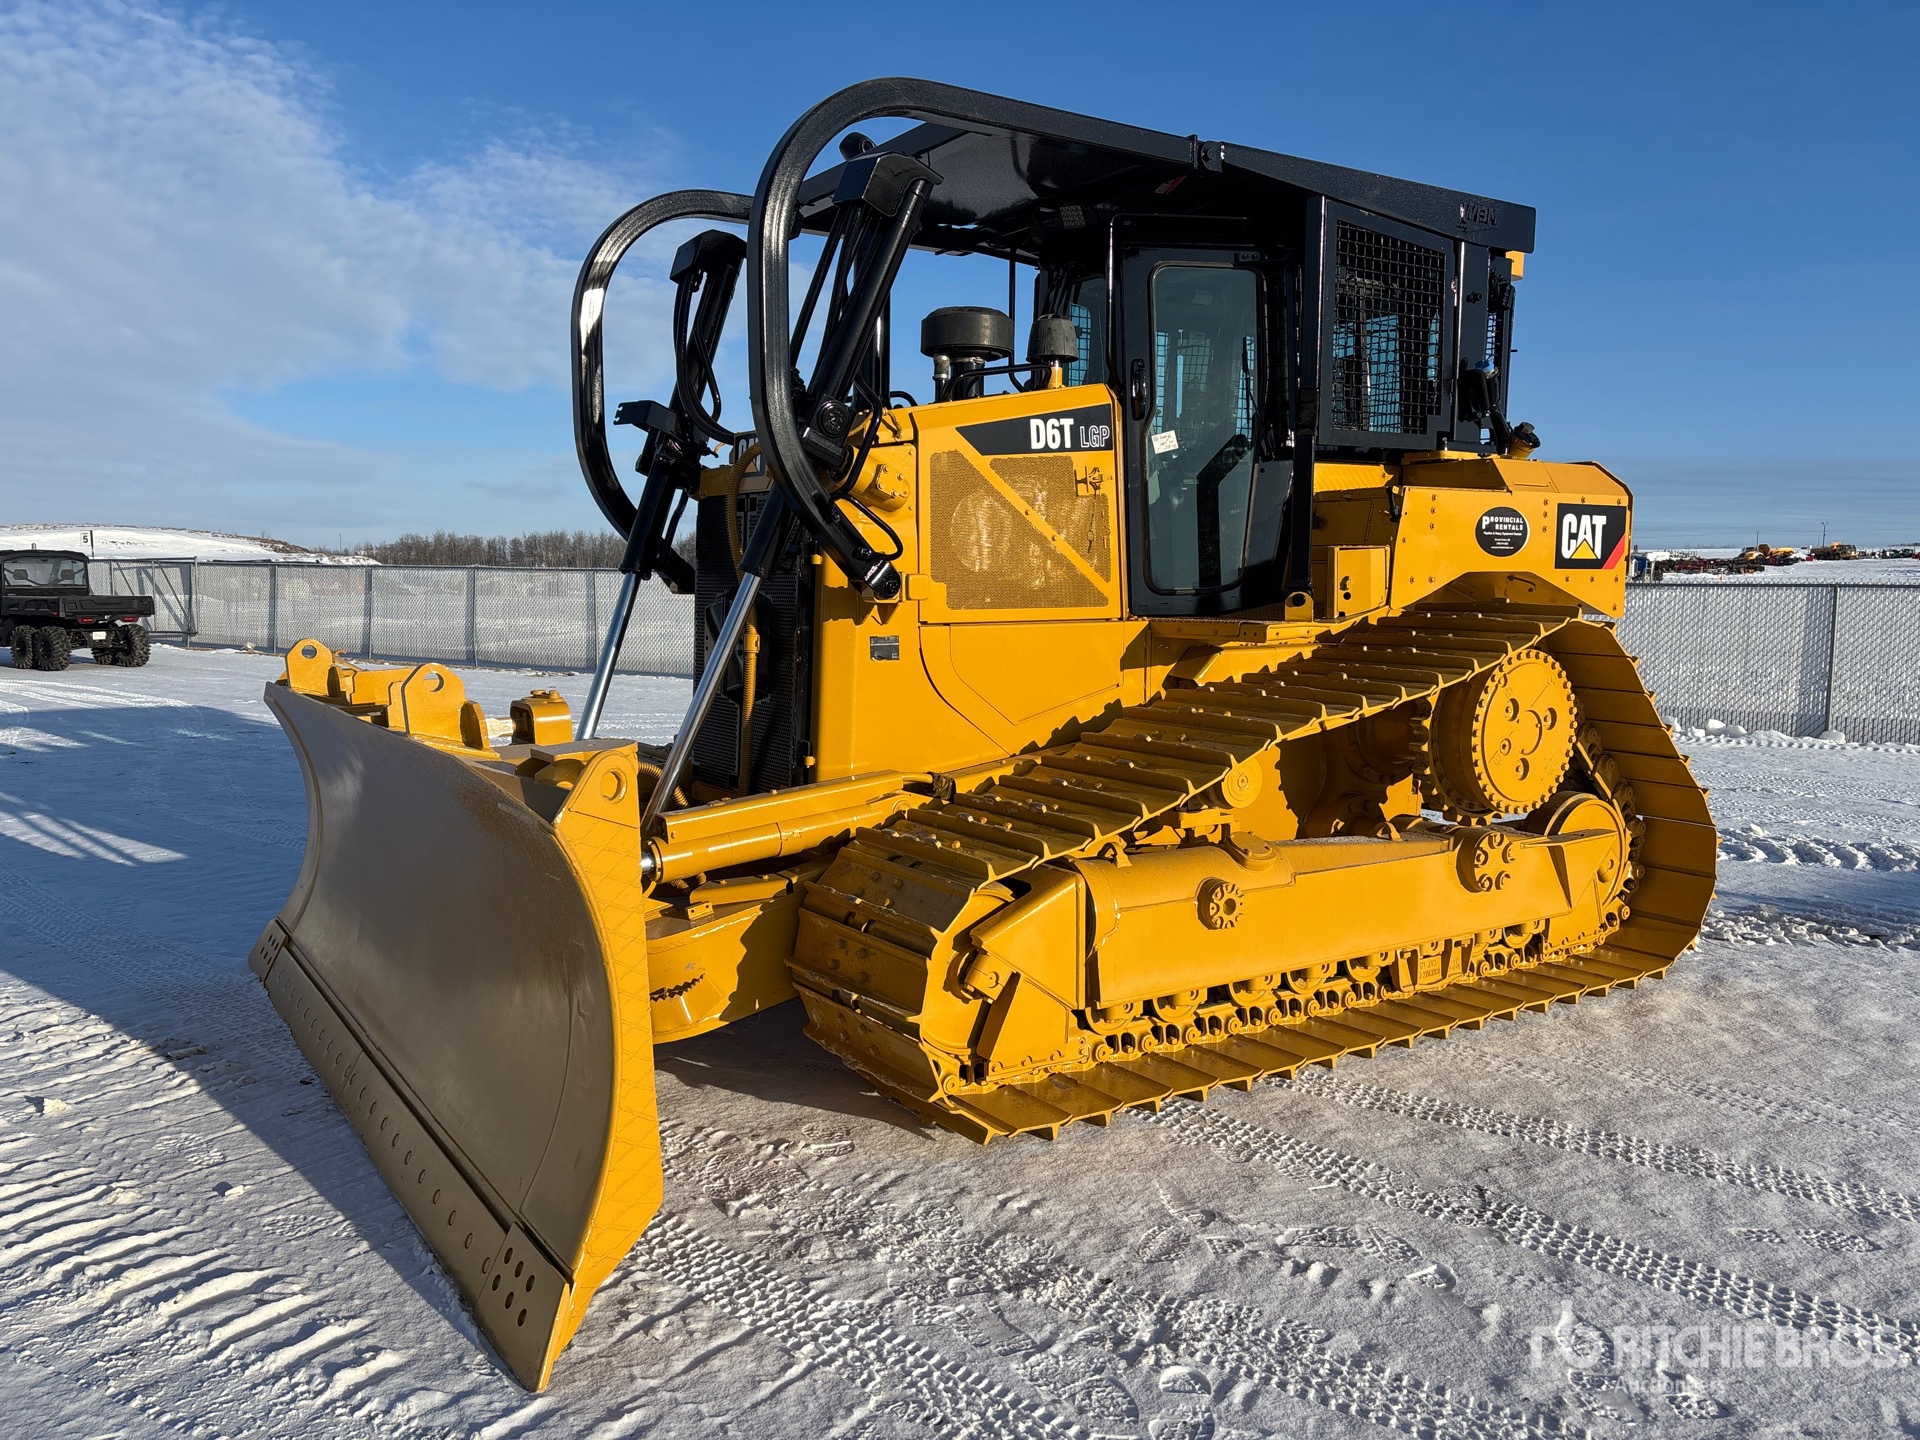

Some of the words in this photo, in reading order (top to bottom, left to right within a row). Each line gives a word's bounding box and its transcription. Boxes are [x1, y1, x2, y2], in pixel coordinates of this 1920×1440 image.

[1030, 418, 1074, 449] D6T
[1080, 425, 1110, 448] LGP
[1481, 515, 1524, 530] PROVINCIAL
[1494, 523, 1524, 531] RENTALS
[82, 535, 89, 544] 5
[1561, 513, 1607, 560] CAT
